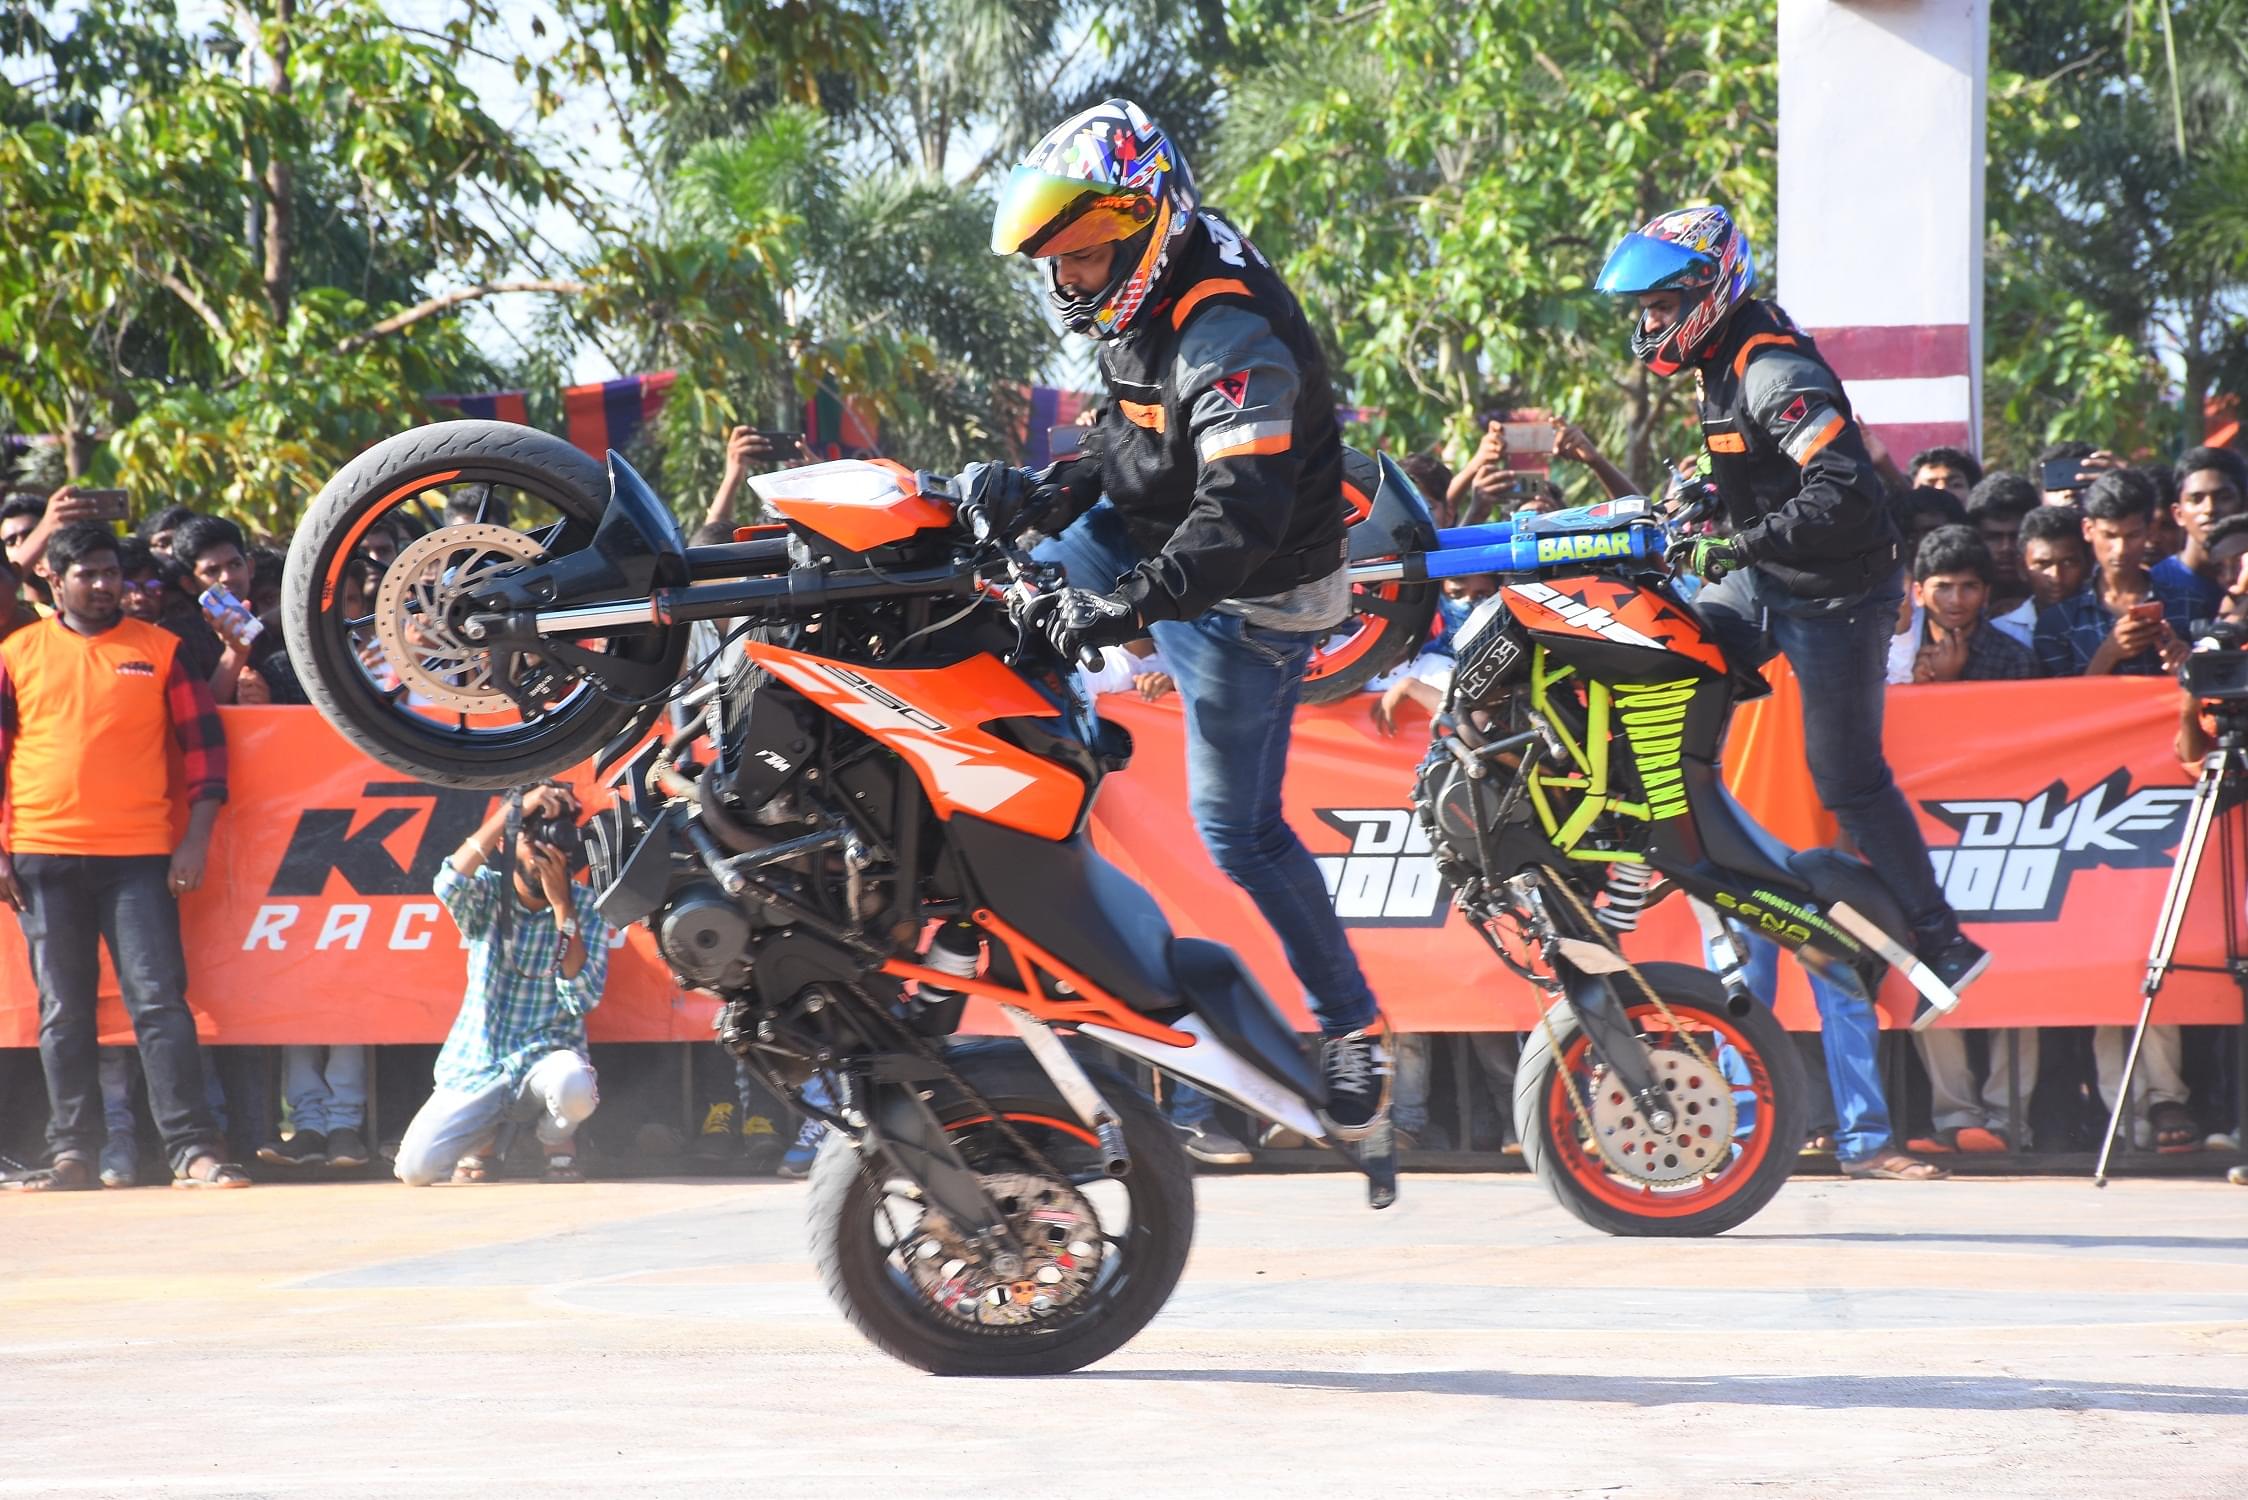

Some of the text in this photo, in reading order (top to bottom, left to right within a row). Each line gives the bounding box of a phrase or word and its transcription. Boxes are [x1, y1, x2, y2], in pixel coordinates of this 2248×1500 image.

[1538, 532, 1632, 562] BABAR
[1507, 582, 1668, 650] DUKE
[1612, 677, 1700, 821] SQUADRANN
[1939, 782, 2198, 850] DUKE
